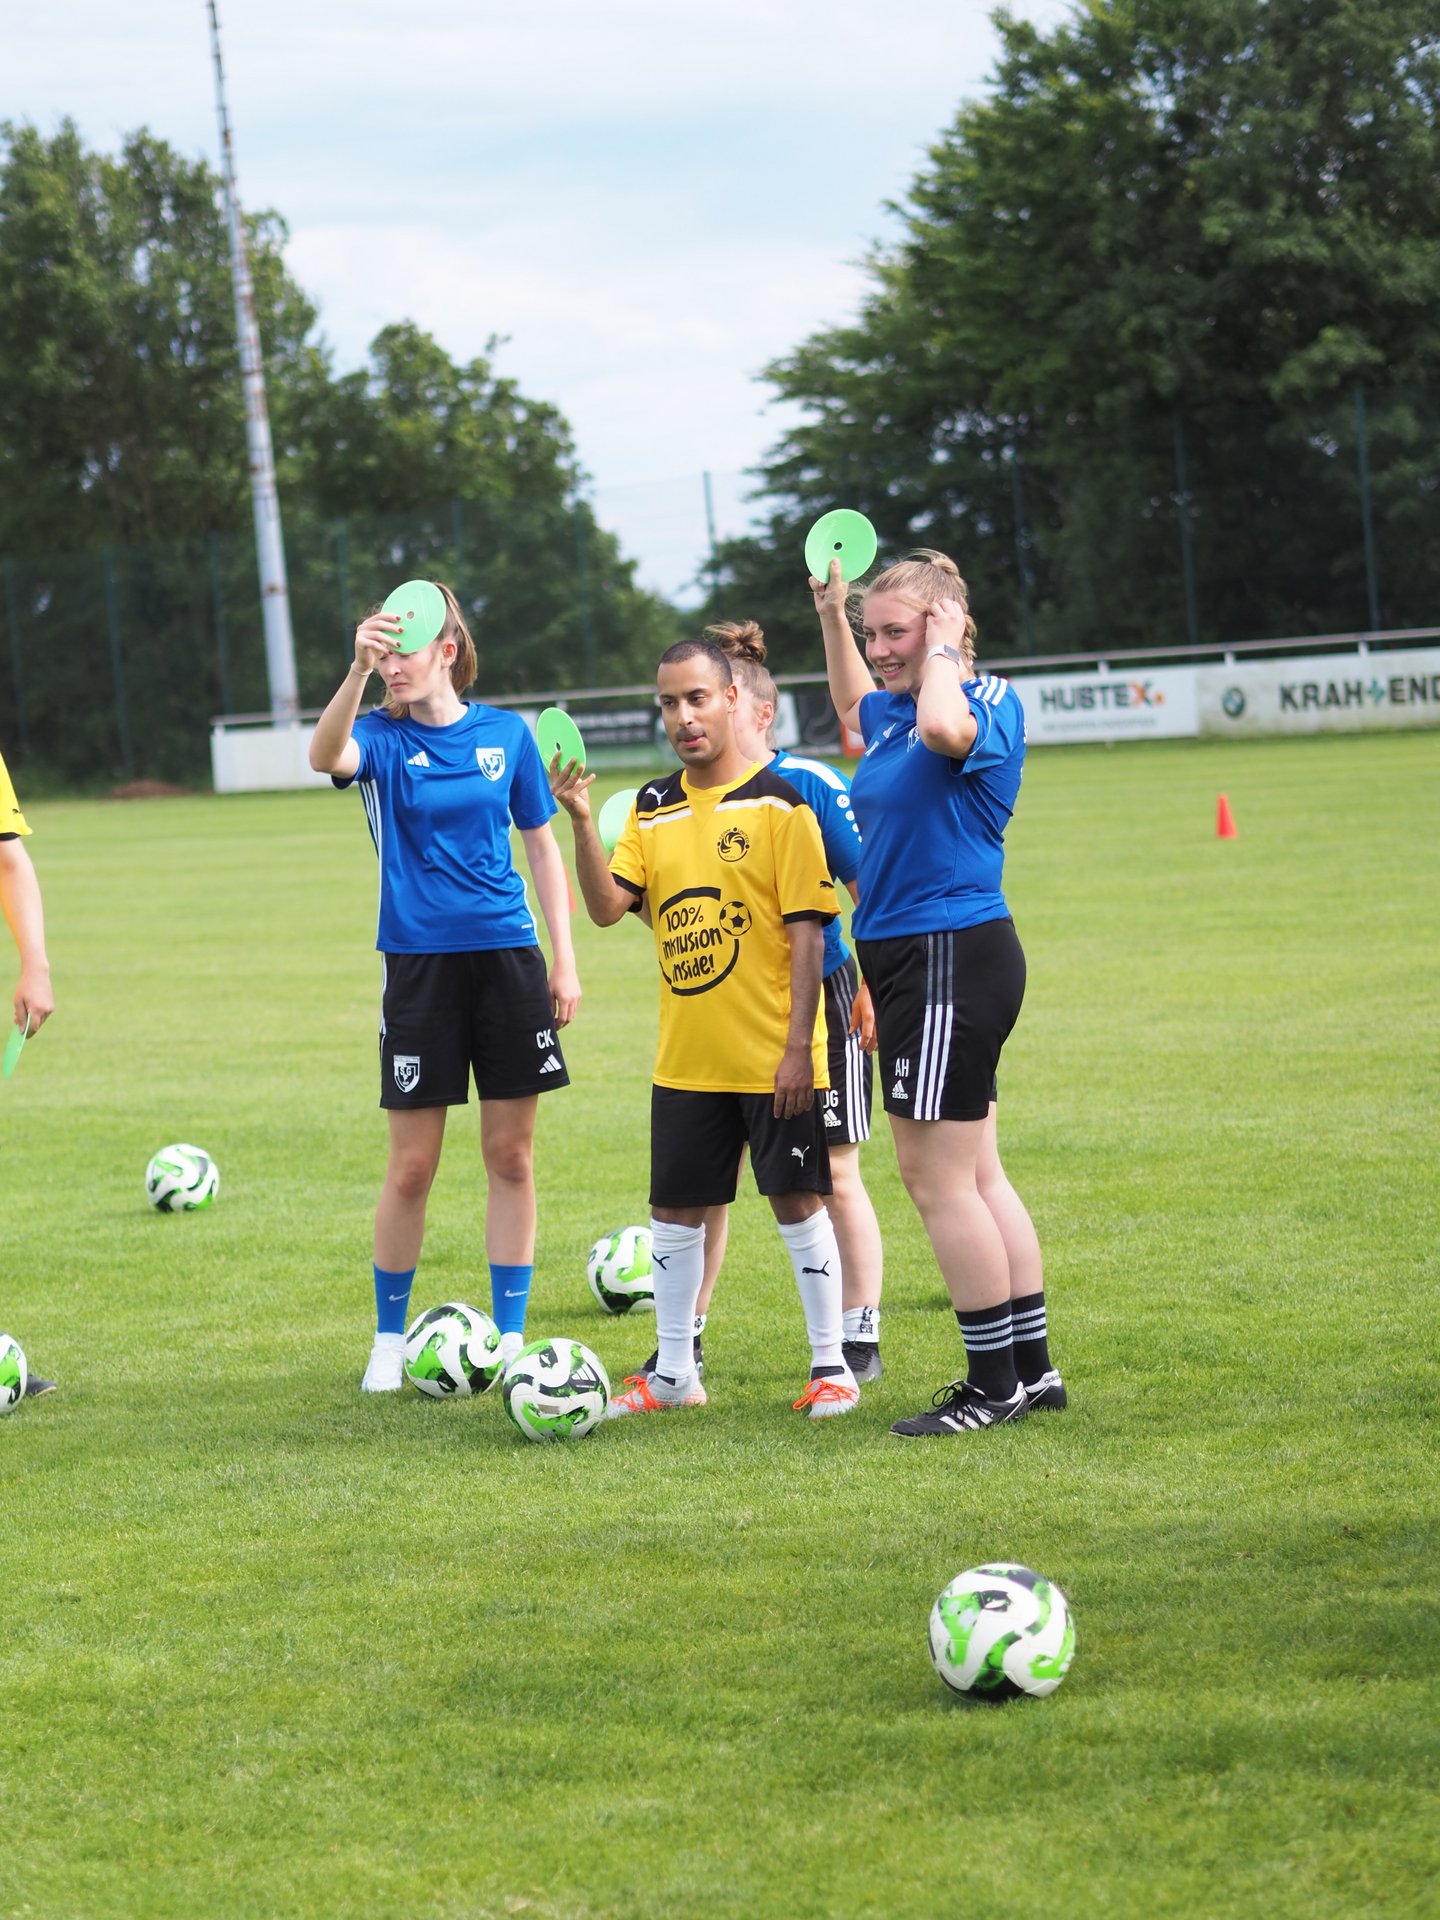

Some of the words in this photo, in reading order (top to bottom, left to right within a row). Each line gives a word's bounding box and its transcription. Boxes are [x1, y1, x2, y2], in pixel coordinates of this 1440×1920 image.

[1040, 681, 1153, 713] HUBTEX
[665, 904, 704, 933] 100%
[535, 1028, 556, 1050] CK
[894, 1057, 910, 1078] AH
